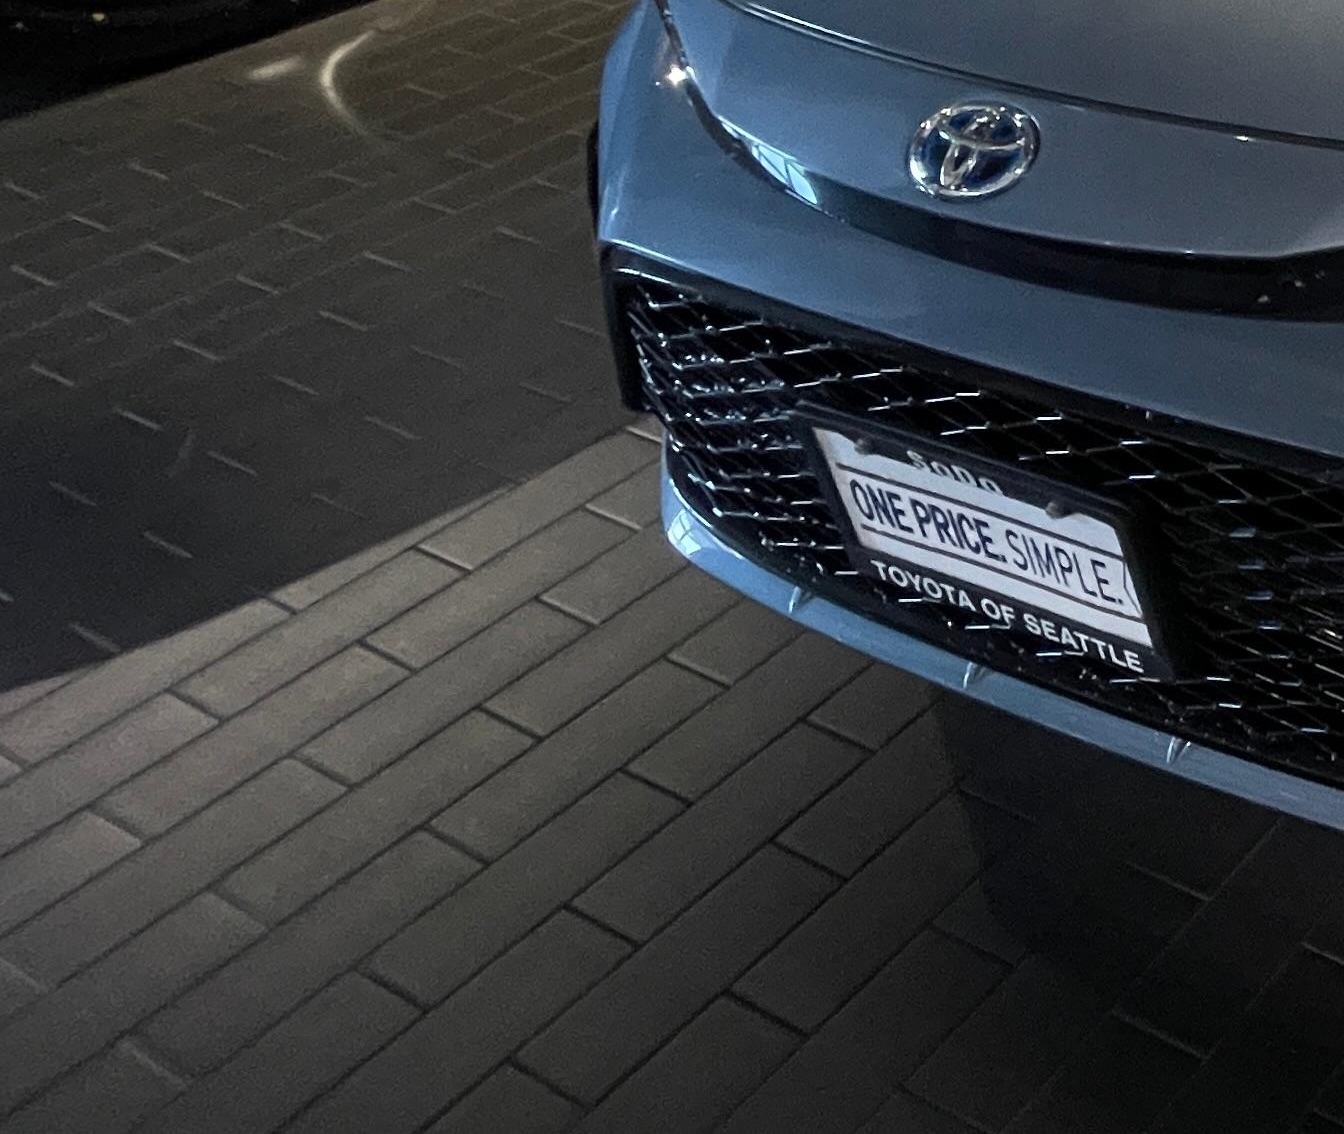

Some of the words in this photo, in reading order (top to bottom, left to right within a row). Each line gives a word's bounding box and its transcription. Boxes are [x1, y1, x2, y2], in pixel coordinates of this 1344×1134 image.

[850, 479, 914, 533] ONE
[909, 497, 1007, 563] PRICE.
[1005, 529, 1123, 604] SIMPLE.
[870, 559, 976, 612] TOYOTA
[980, 598, 1015, 623] OF
[1023, 612, 1144, 673] SEATTLE
